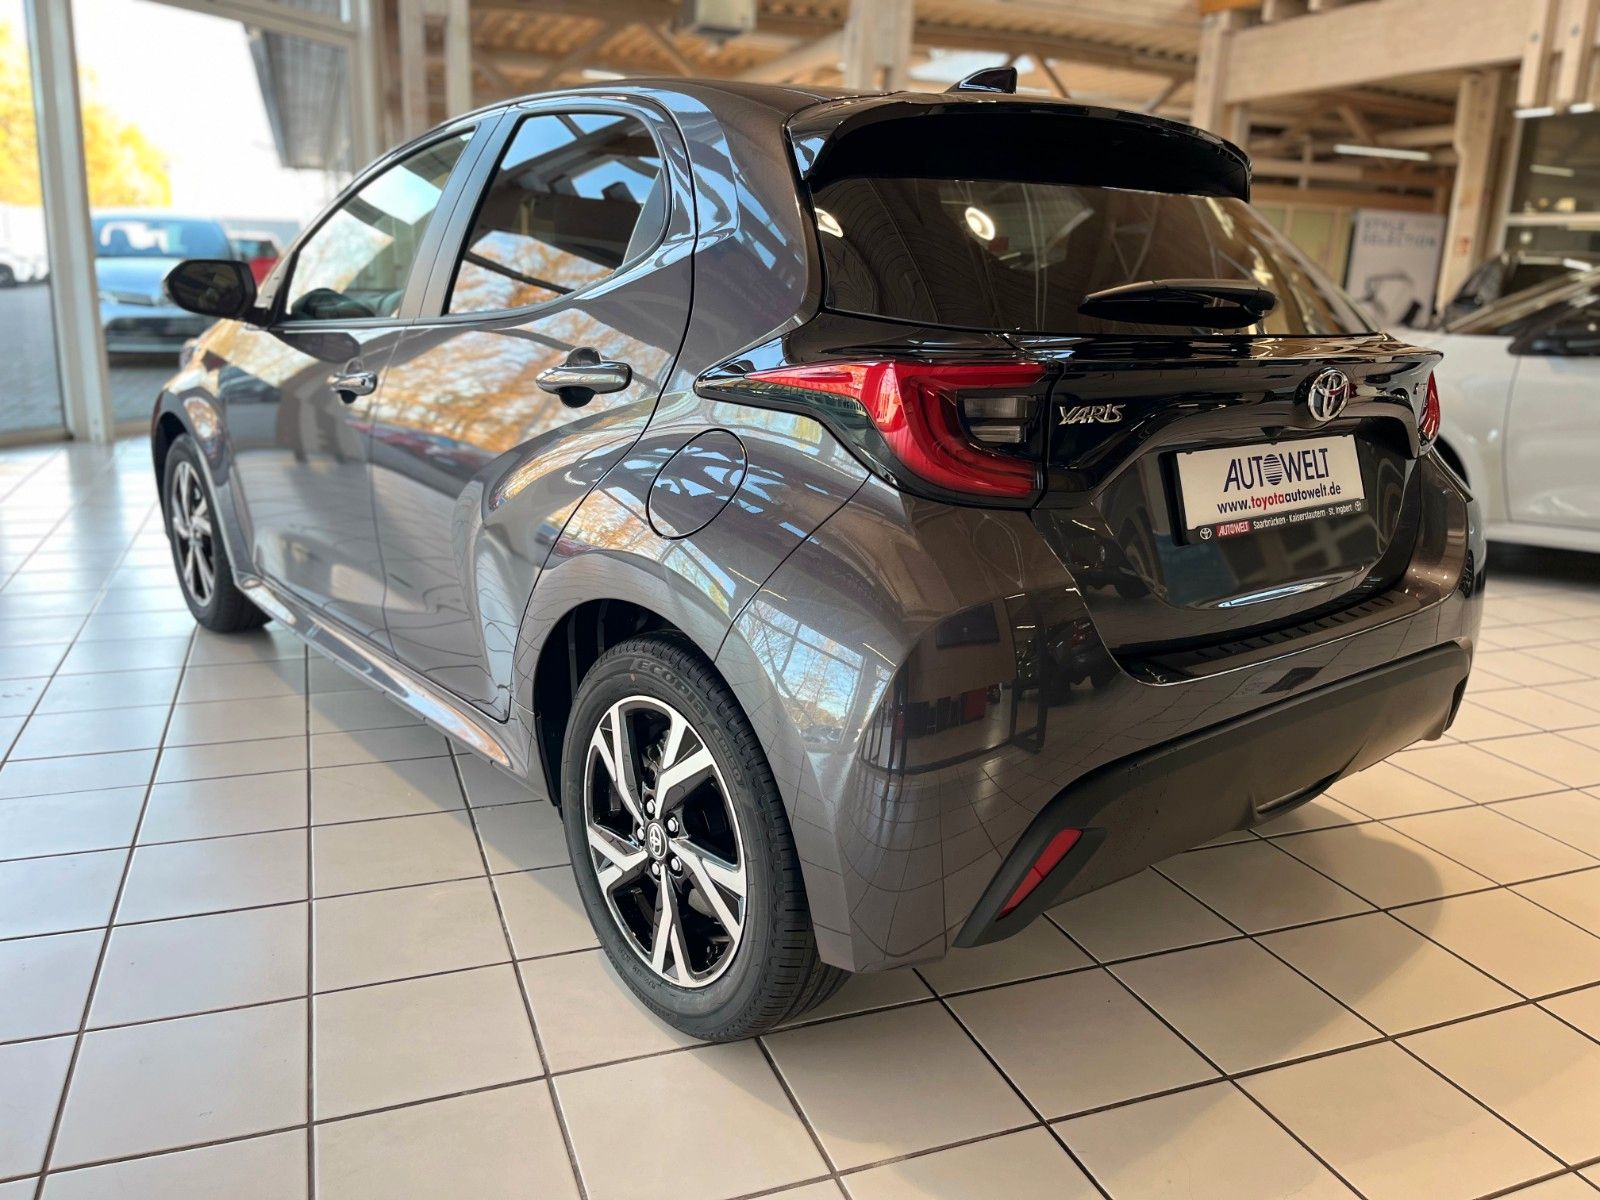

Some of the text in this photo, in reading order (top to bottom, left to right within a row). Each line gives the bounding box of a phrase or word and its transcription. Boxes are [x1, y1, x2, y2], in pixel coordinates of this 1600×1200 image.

[1059, 403, 1126, 425] YARIS
[1223, 448, 1330, 492] AUTOWELT
[1217, 482, 1342, 514] www.toyotaautowelt.de
[1218, 521, 1250, 537] AUTOWELT
